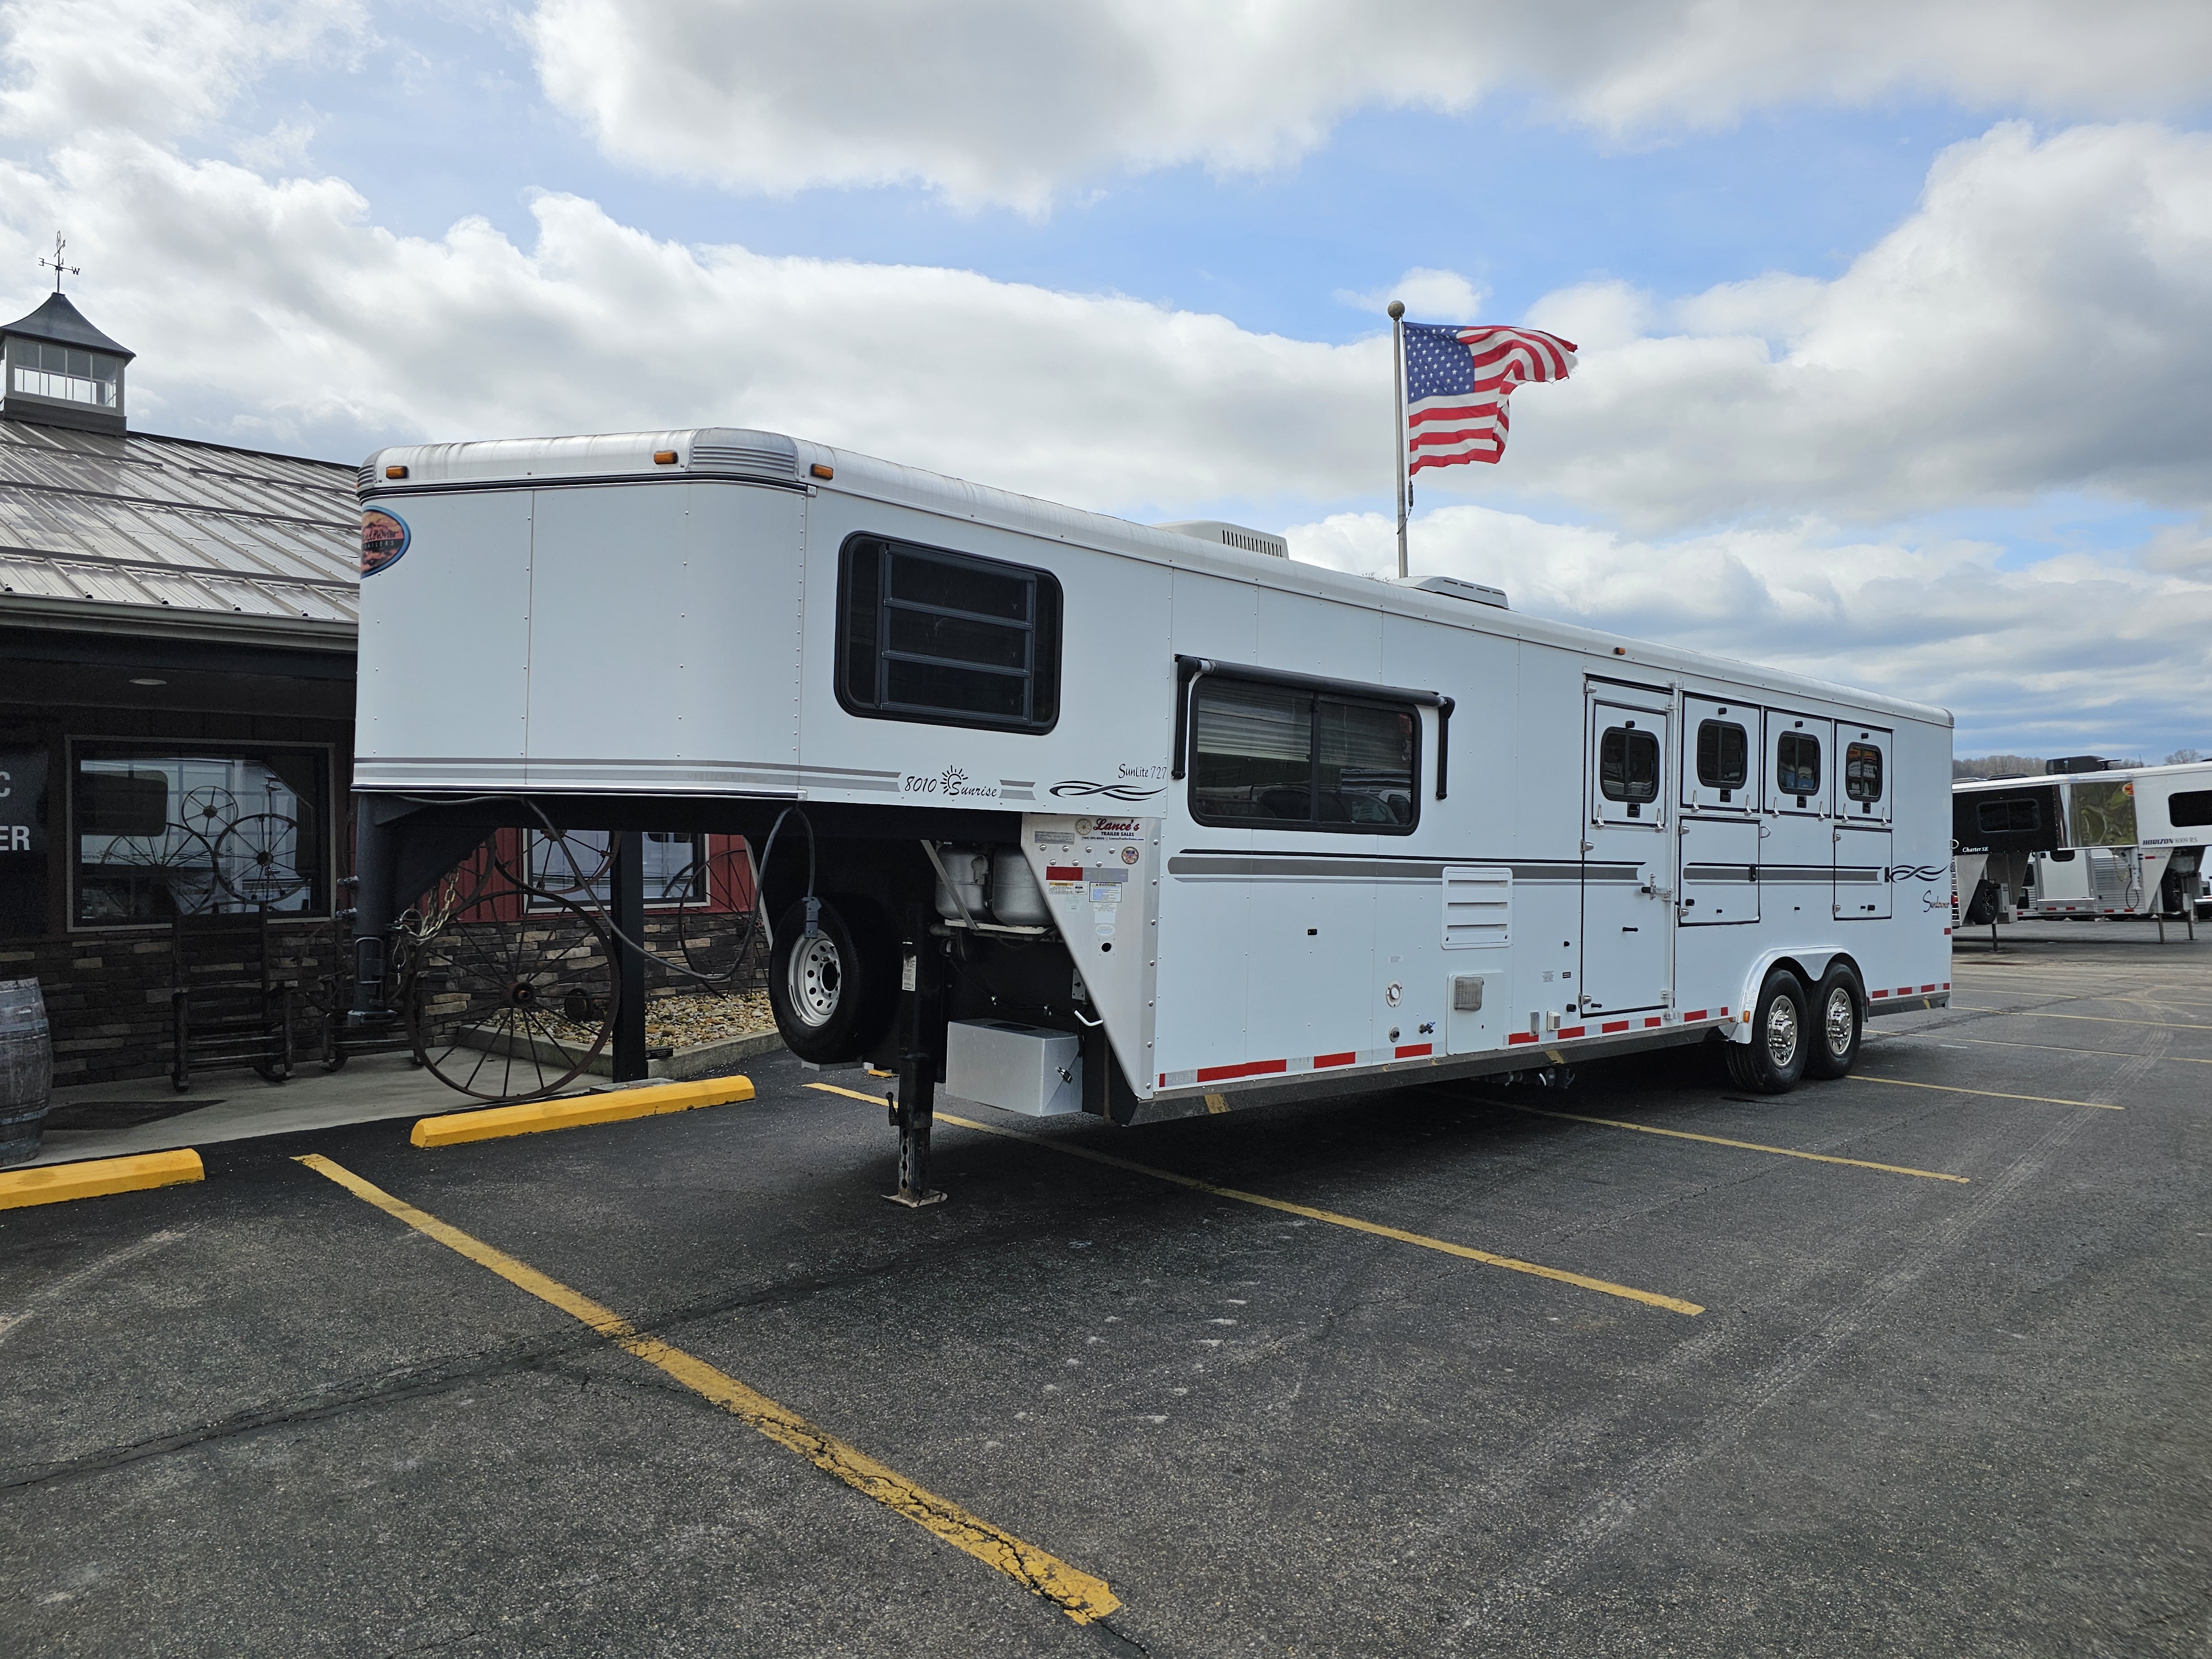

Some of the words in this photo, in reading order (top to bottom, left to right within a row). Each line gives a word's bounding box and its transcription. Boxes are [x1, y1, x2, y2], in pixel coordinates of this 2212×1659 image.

[1118, 764, 1149, 779] SunLite
[1151, 766, 1167, 779] 727
[905, 776, 937, 792] 8010
[949, 781, 997, 797] Sunrise
[1093, 818, 1140, 831] Lance's
